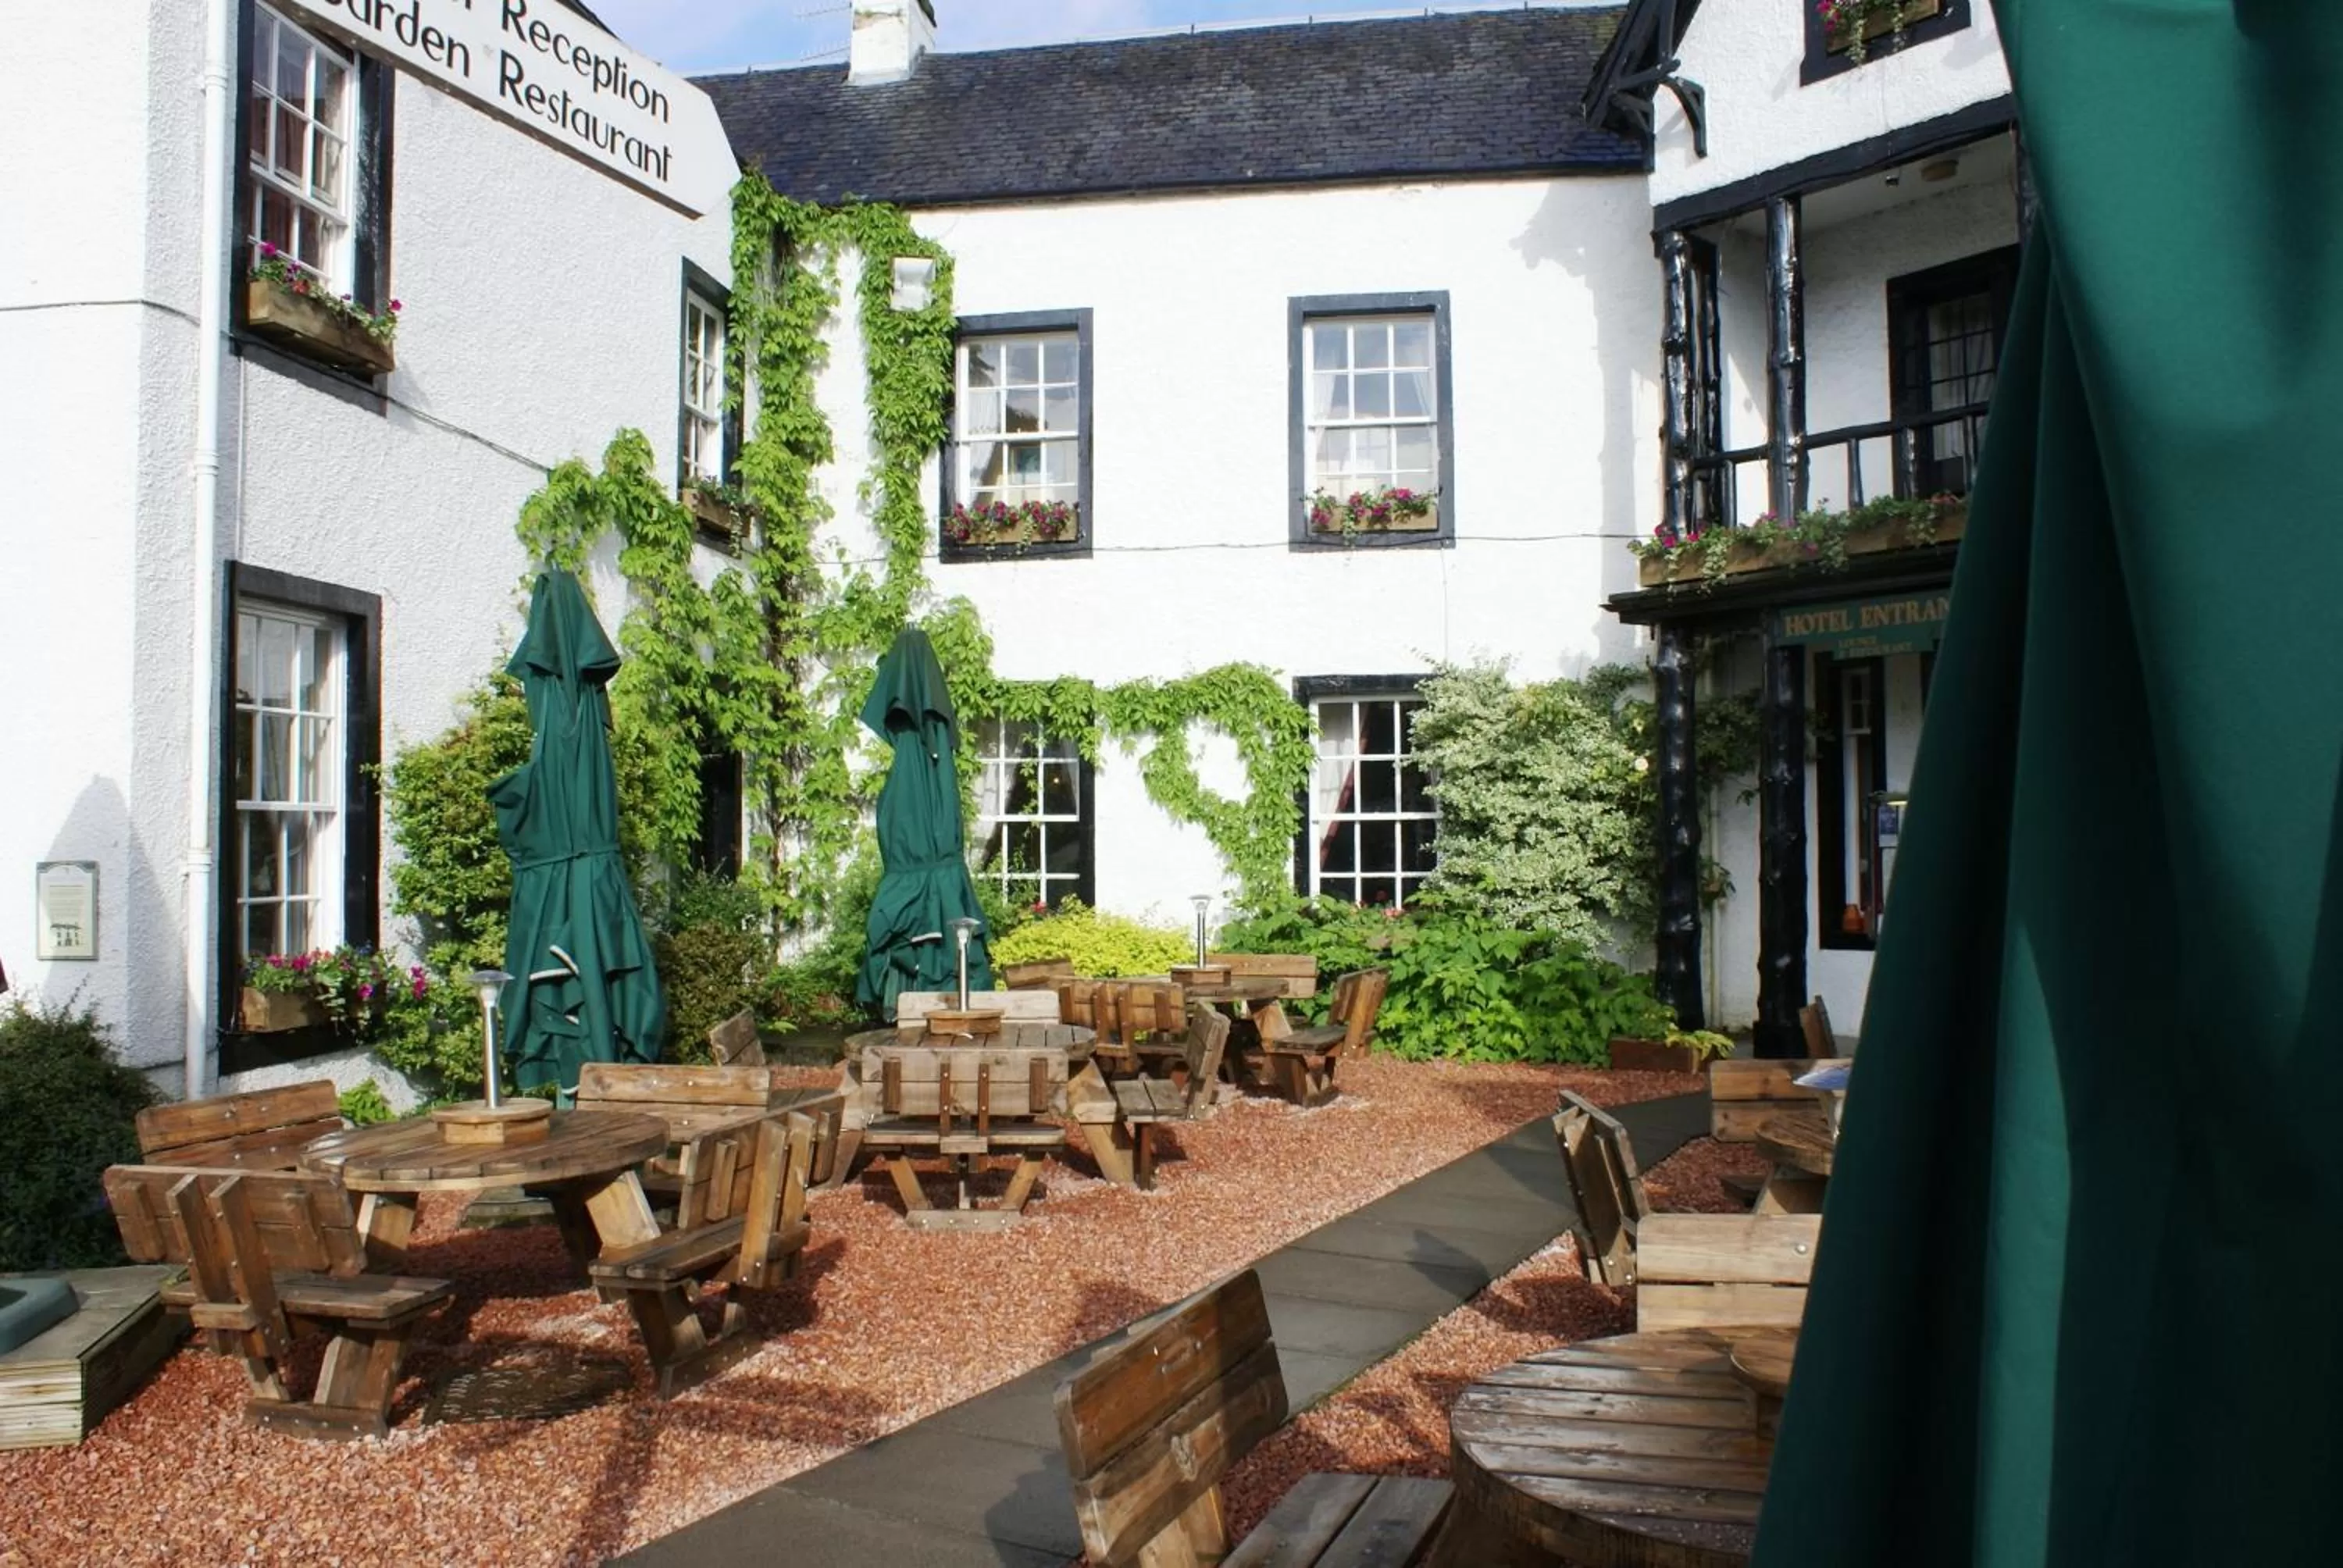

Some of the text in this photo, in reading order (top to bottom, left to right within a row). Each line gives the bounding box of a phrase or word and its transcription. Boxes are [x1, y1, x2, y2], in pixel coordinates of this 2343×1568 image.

[325, 0, 672, 182] arden Restaurant
[501, 0, 669, 123] Reception
[1785, 611, 1853, 637] HOTEL
